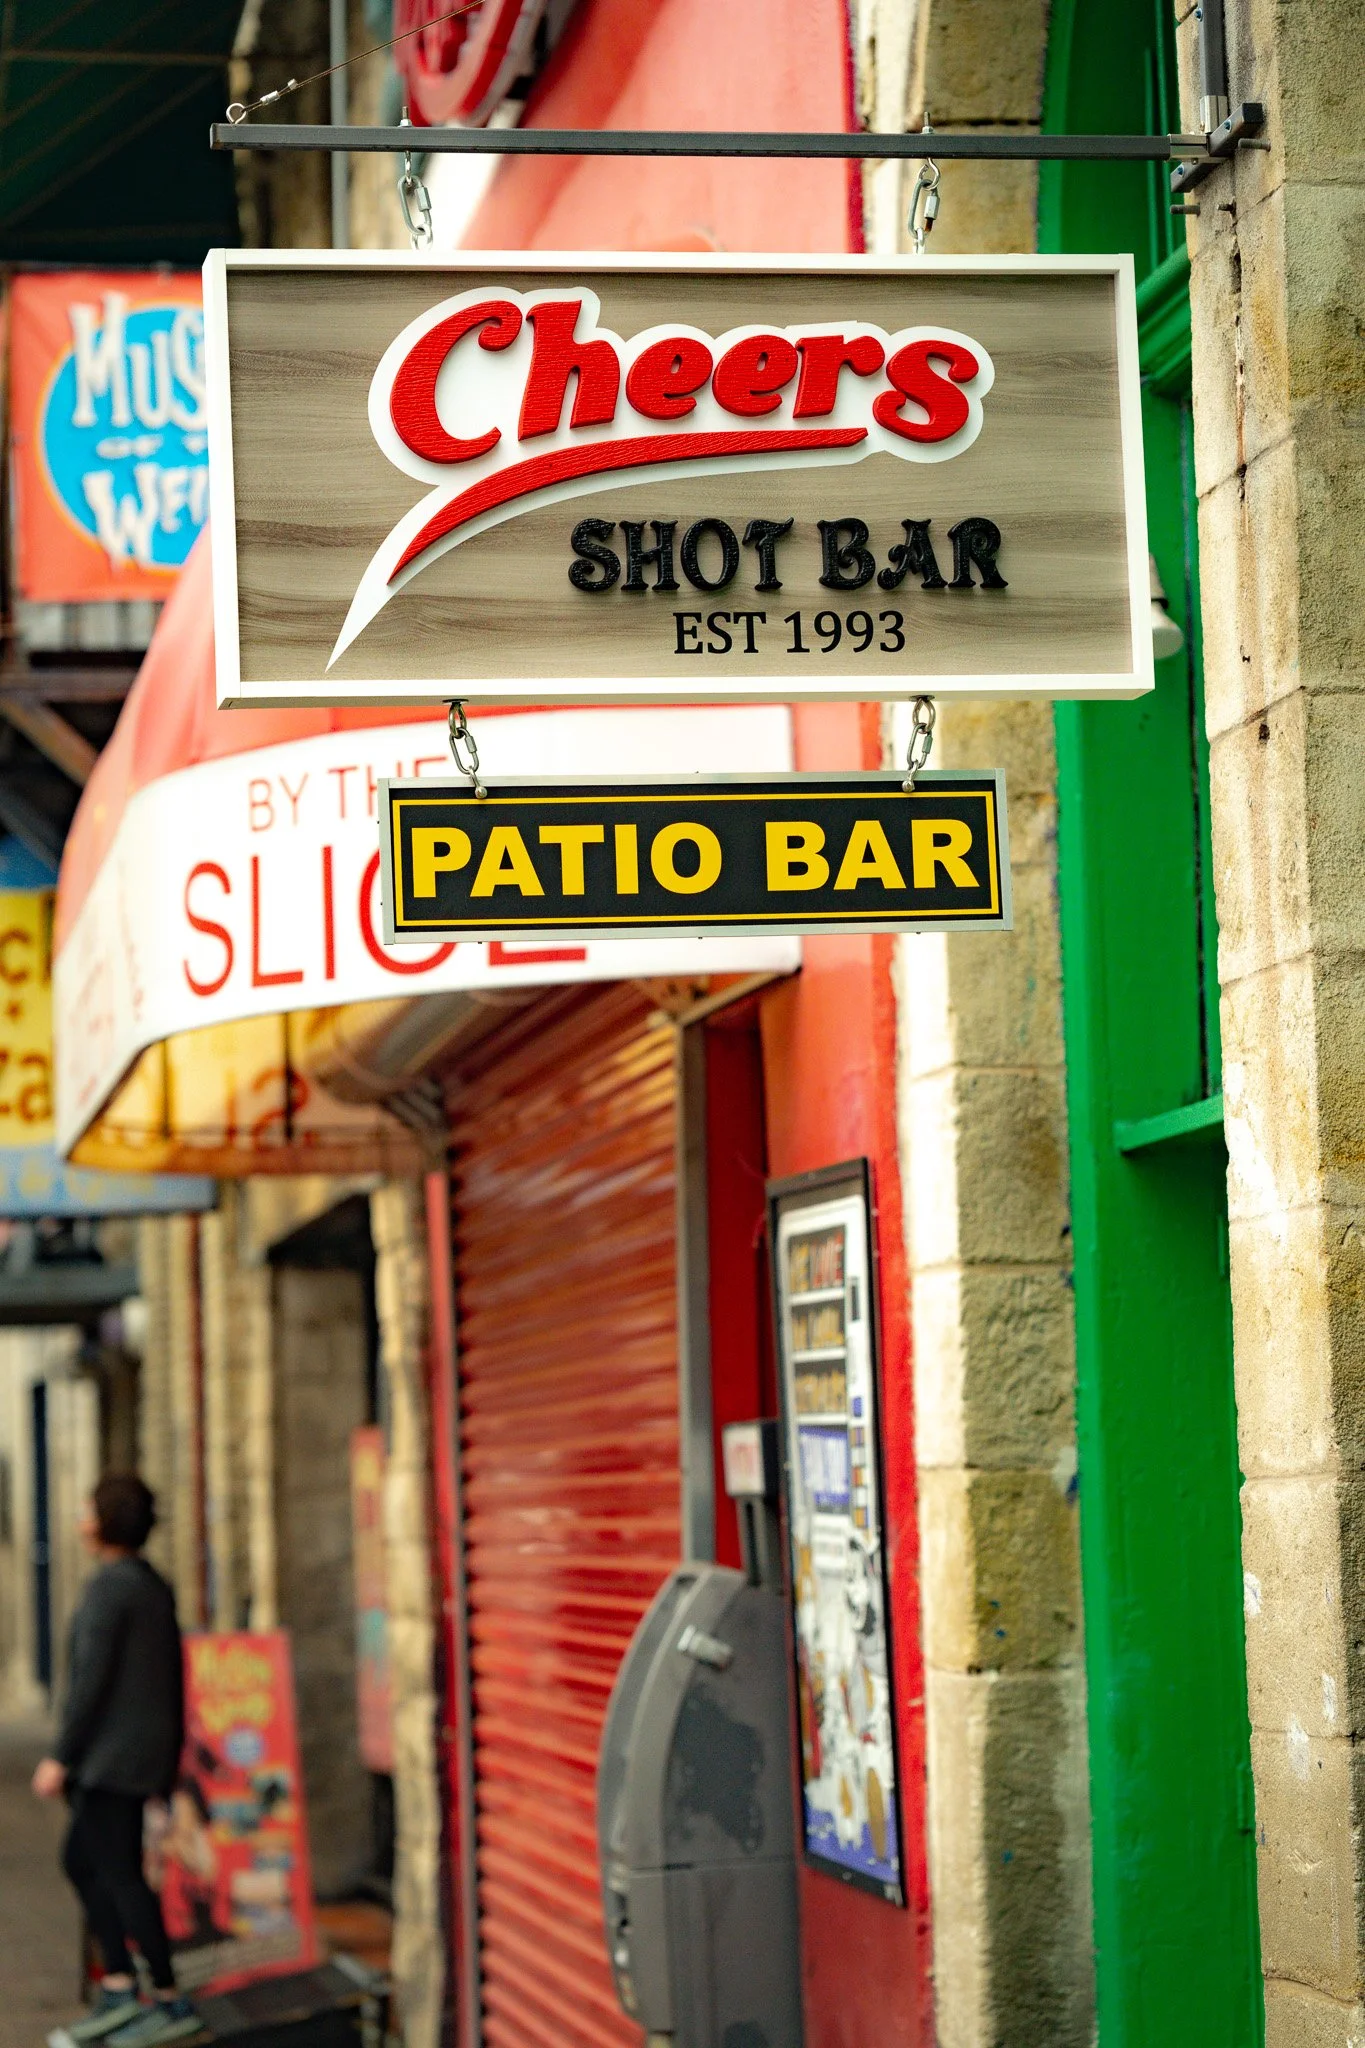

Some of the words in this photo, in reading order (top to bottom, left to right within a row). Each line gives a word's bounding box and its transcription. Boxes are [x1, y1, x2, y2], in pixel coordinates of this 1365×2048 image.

[390, 299, 980, 465] Cheers
[567, 517, 795, 592] SHOT
[817, 516, 1008, 590] BAR
[673, 612, 767, 655] EST
[785, 610, 907, 654] 1993
[248, 773, 309, 833] BY
[328, 756, 448, 820] TH
[411, 821, 723, 898] PATIO
[764, 818, 980, 892] BAR
[183, 844, 588, 998] SLIC
